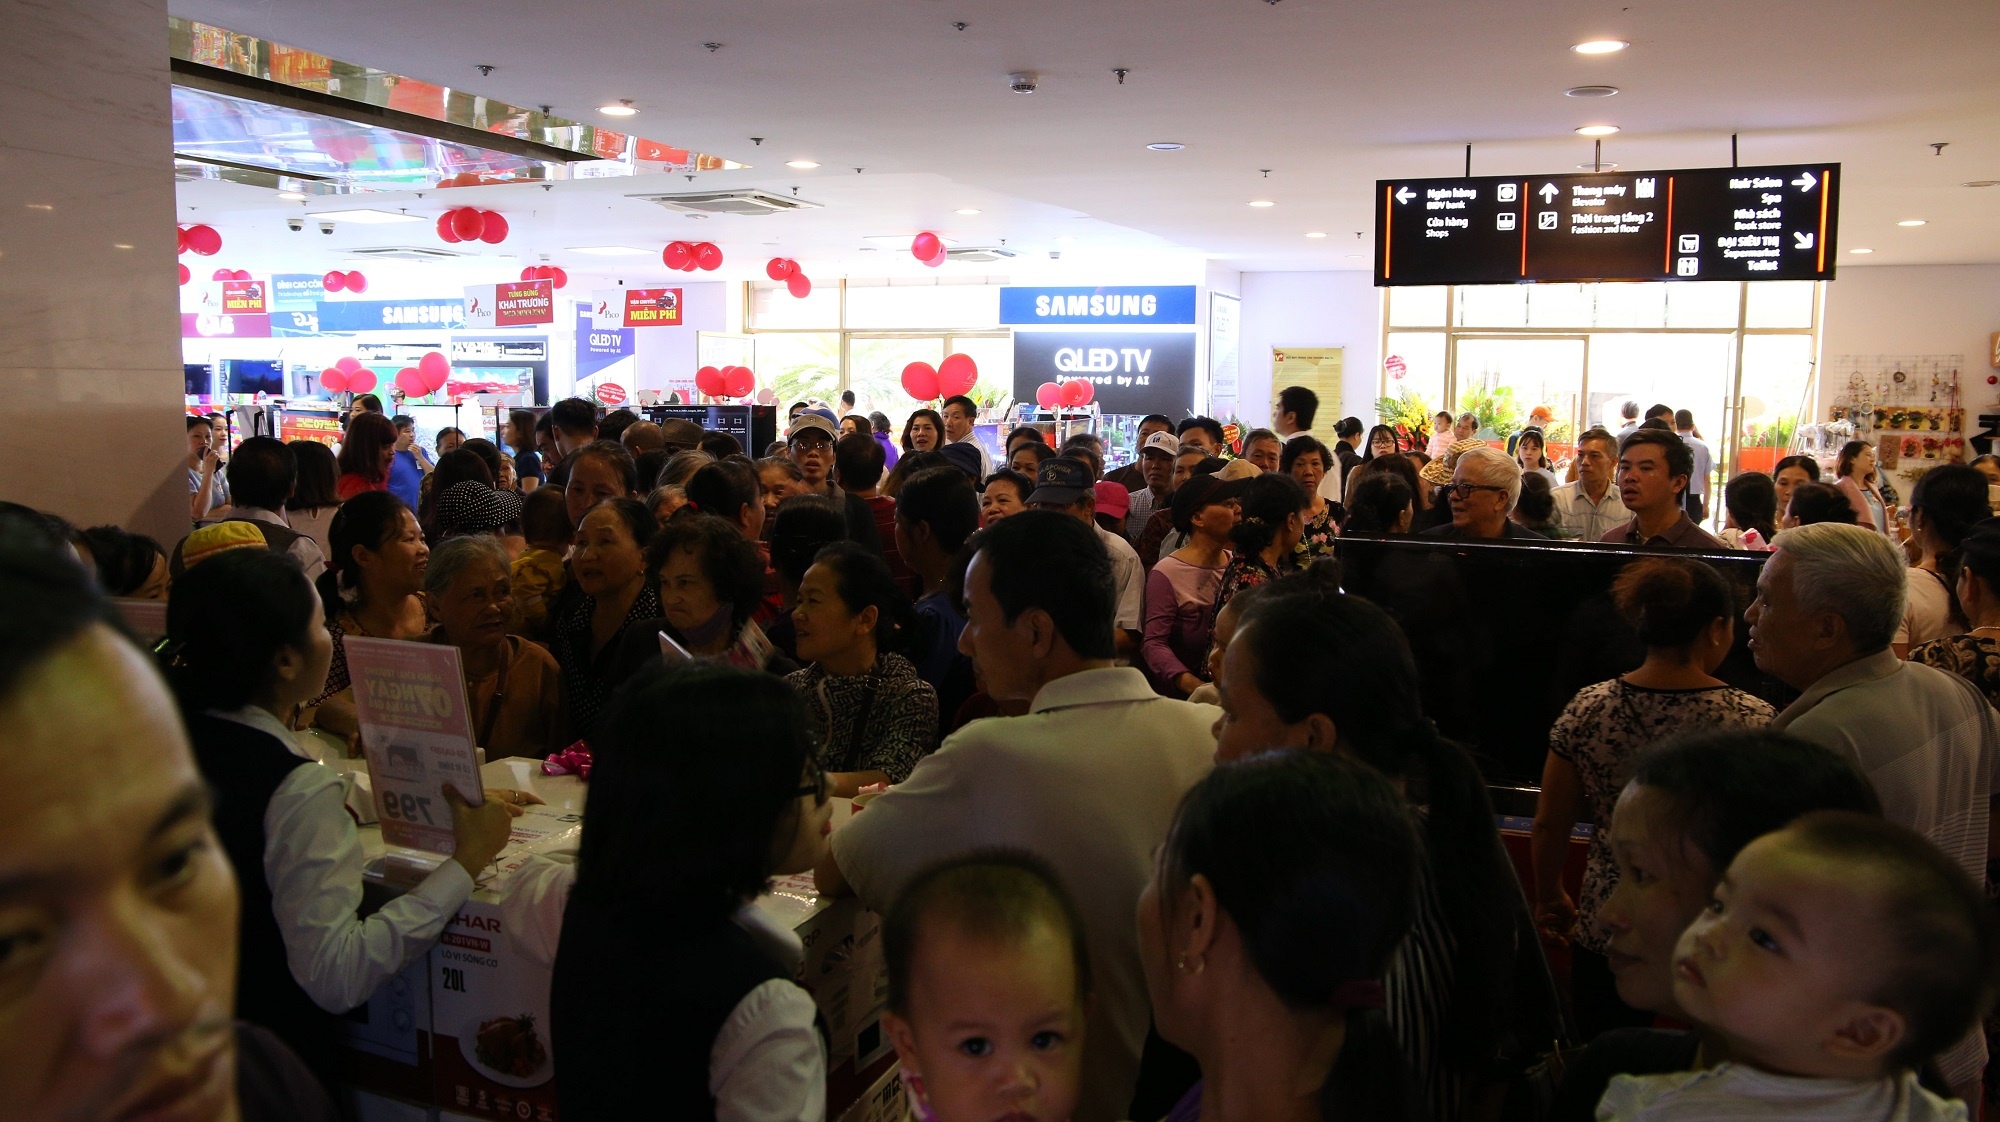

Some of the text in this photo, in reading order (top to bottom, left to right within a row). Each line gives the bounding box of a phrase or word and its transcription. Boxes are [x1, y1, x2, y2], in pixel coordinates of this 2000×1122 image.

[1730, 177, 1782, 189] Hair Salon
[1427, 188, 1476, 200] Ngân hàng
[1572, 185, 1626, 197] Thang máy
[1426, 200, 1466, 210] BIDV bank
[1572, 198, 1606, 206] Elevator
[1761, 193, 1782, 205] Spa
[1572, 213, 1593, 224] Thời
[1594, 214, 1620, 225] trang
[1646, 212, 1654, 222] 2
[1734, 208, 1782, 219] Nhà sách
[1427, 217, 1468, 228] Cửa hàng
[1734, 221, 1782, 230] Book store
[1426, 229, 1449, 238] Shops
[1572, 224, 1640, 234] Fashion 2nd floor
[1738, 234, 1761, 247] SIÊU
[1762, 236, 1780, 248] THỊ
[1724, 248, 1780, 260] Supermarket
[1747, 260, 1778, 270] Toilet
[227, 297, 262, 308] MIỄN PHÍ
[498, 298, 548, 310] KHAI TRƯƠNG
[1036, 295, 1156, 316] SAMSUNG
[382, 305, 464, 324] SAMSUNG
[604, 310, 620, 318] Pico
[630, 307, 676, 320] MIỄN PHÍ
[590, 334, 622, 346] QLED TV
[1054, 348, 1152, 372] QLED TV
[1117, 376, 1132, 388] by
[1136, 376, 1150, 386] AI
[314, 420, 324, 428] 07
[448, 913, 501, 934] HAR
[442, 966, 466, 992] 20L
